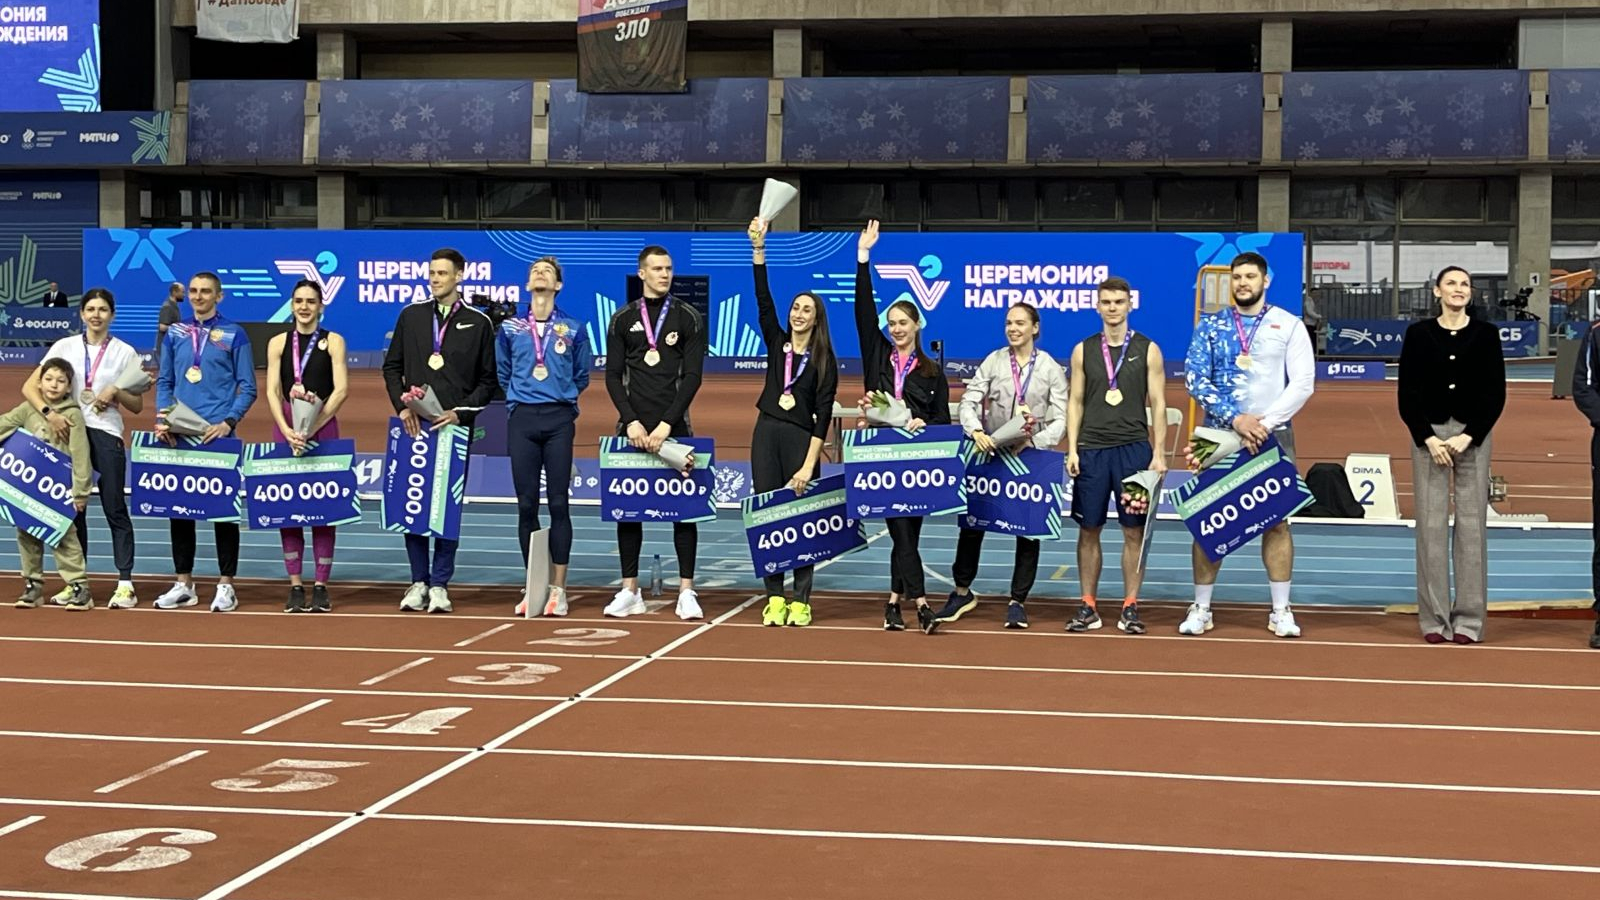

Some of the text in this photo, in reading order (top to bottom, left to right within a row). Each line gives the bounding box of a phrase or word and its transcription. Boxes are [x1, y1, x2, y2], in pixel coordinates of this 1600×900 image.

[614, 17, 650, 42] ЗЛО
[358, 261, 491, 282] ЦЕРЕМИЯ
[964, 265, 1109, 287] ЦЕРЕМОНИЯ
[1312, 262, 1350, 270] ШТОРЫ
[1531, 274, 1538, 284] 1
[25, 320, 70, 329] ФОСАГРО
[1342, 364, 1365, 373] ПСБ
[138, 472, 178, 492] 400
[183, 475, 223, 495] 000
[608, 478, 649, 495] 400
[654, 478, 696, 495] 000
[853, 471, 896, 490] 400
[901, 468, 945, 488] 000
[966, 475, 1001, 496] 300
[1005, 480, 1043, 502] 000
[254, 483, 293, 502] 400
[298, 480, 339, 500] 000
[405, 473, 425, 514] 000
[1359, 480, 1375, 505] 2
[1200, 504, 1238, 536] 400
[1240, 478, 1280, 510] 000
[758, 527, 798, 550] 400
[802, 514, 843, 539] 000
[526, 628, 630, 647] 2
[446, 663, 562, 686] 3
[340, 707, 473, 735] 4
[209, 758, 370, 793] 5
[44, 827, 218, 873] 6
